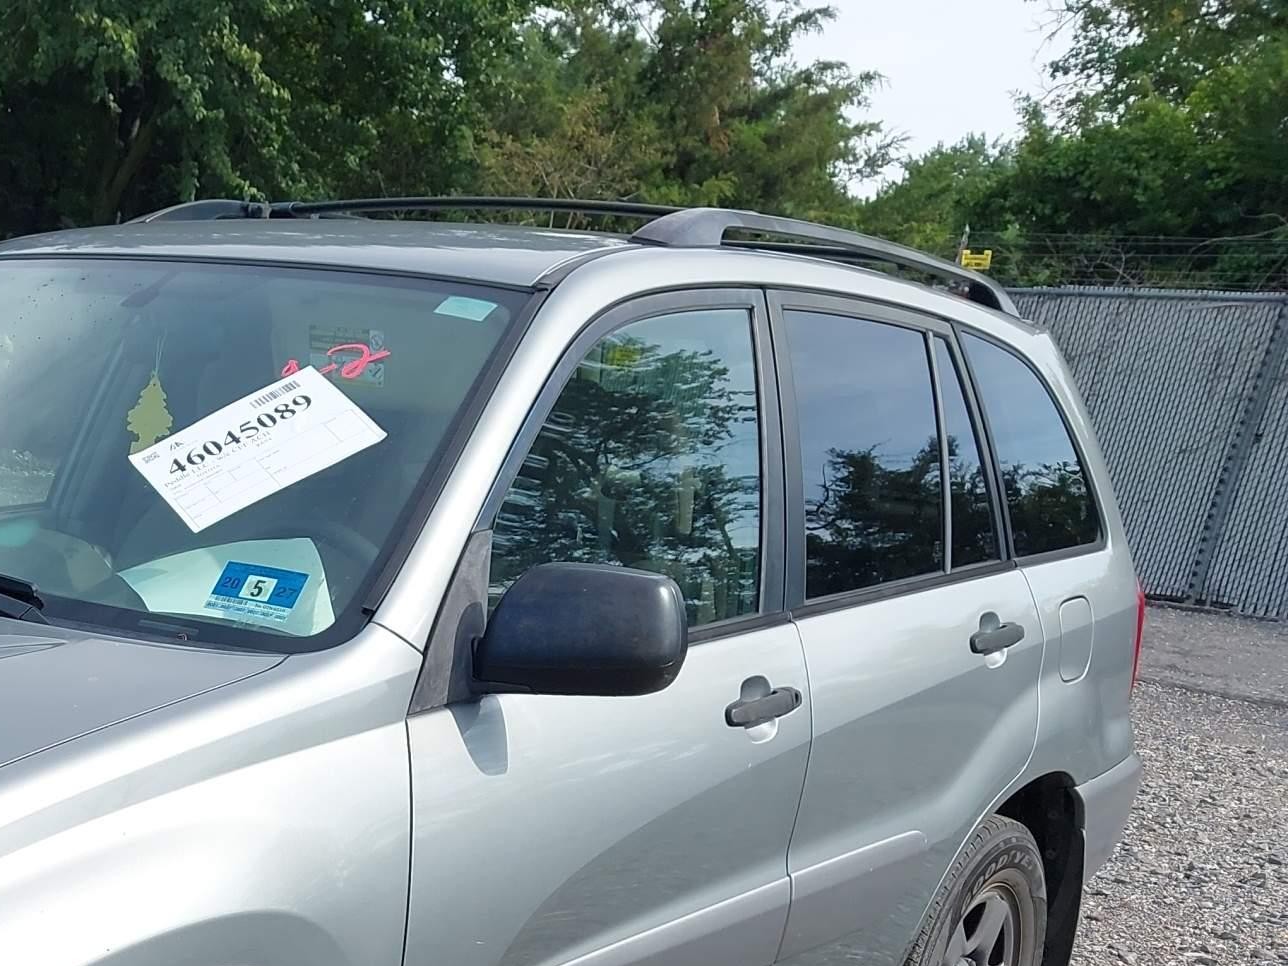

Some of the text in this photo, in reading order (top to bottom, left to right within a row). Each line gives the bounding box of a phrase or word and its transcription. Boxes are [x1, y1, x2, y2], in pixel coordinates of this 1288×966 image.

[169, 394, 313, 475] 46045089
[222, 577, 297, 598] 20 5 27
